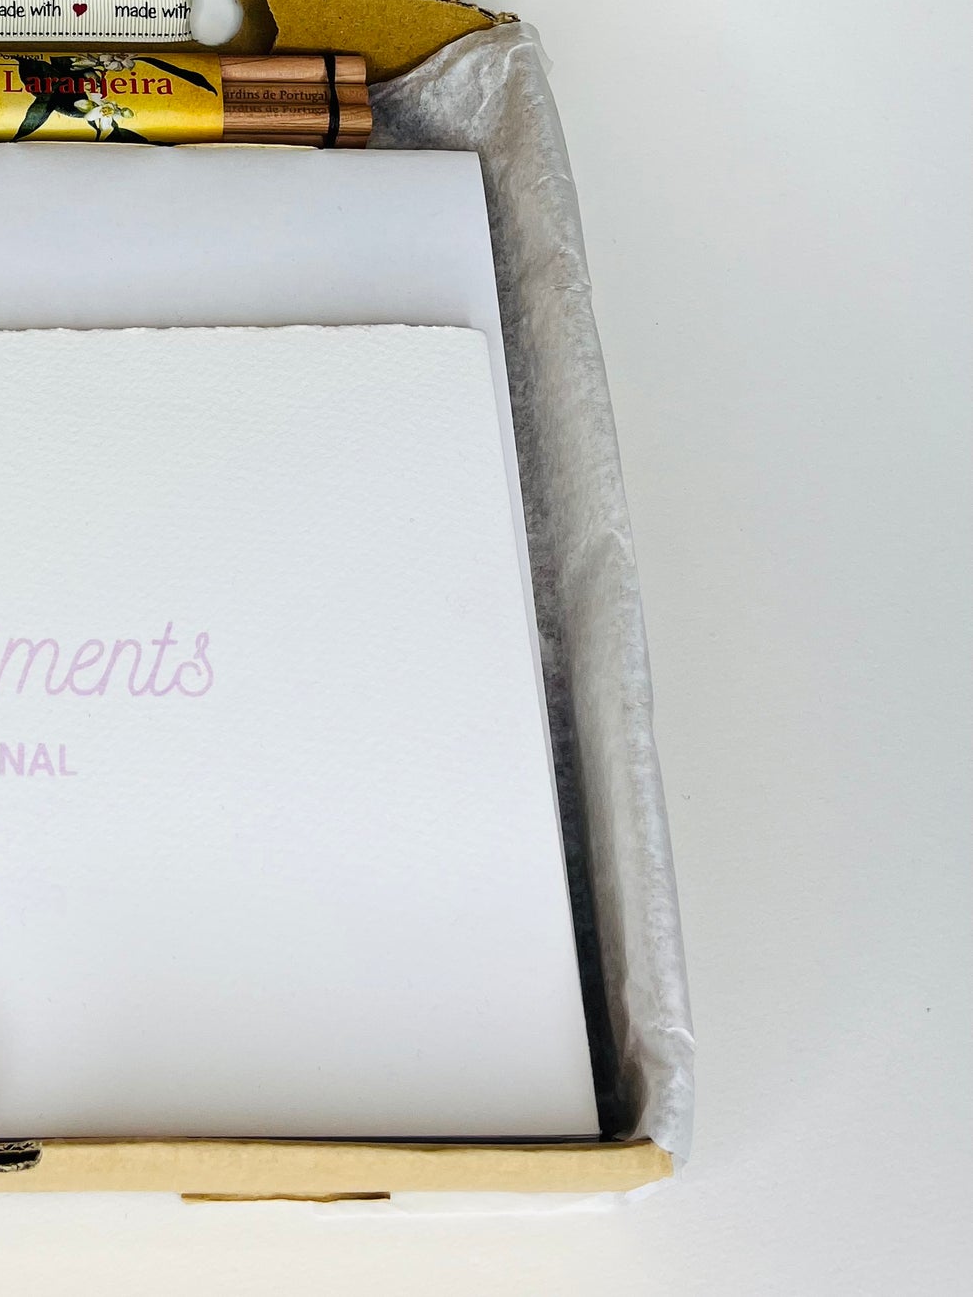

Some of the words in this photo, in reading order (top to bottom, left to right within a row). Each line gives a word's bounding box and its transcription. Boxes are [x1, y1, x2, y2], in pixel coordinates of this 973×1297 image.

[30, 0, 61, 17] with
[114, 1, 157, 19] made
[161, 1, 192, 19] with
[2, 70, 173, 100] Laranjeira
[224, 89, 260, 100] ardins
[262, 91, 277, 101] de
[280, 90, 328, 103] Portugal
